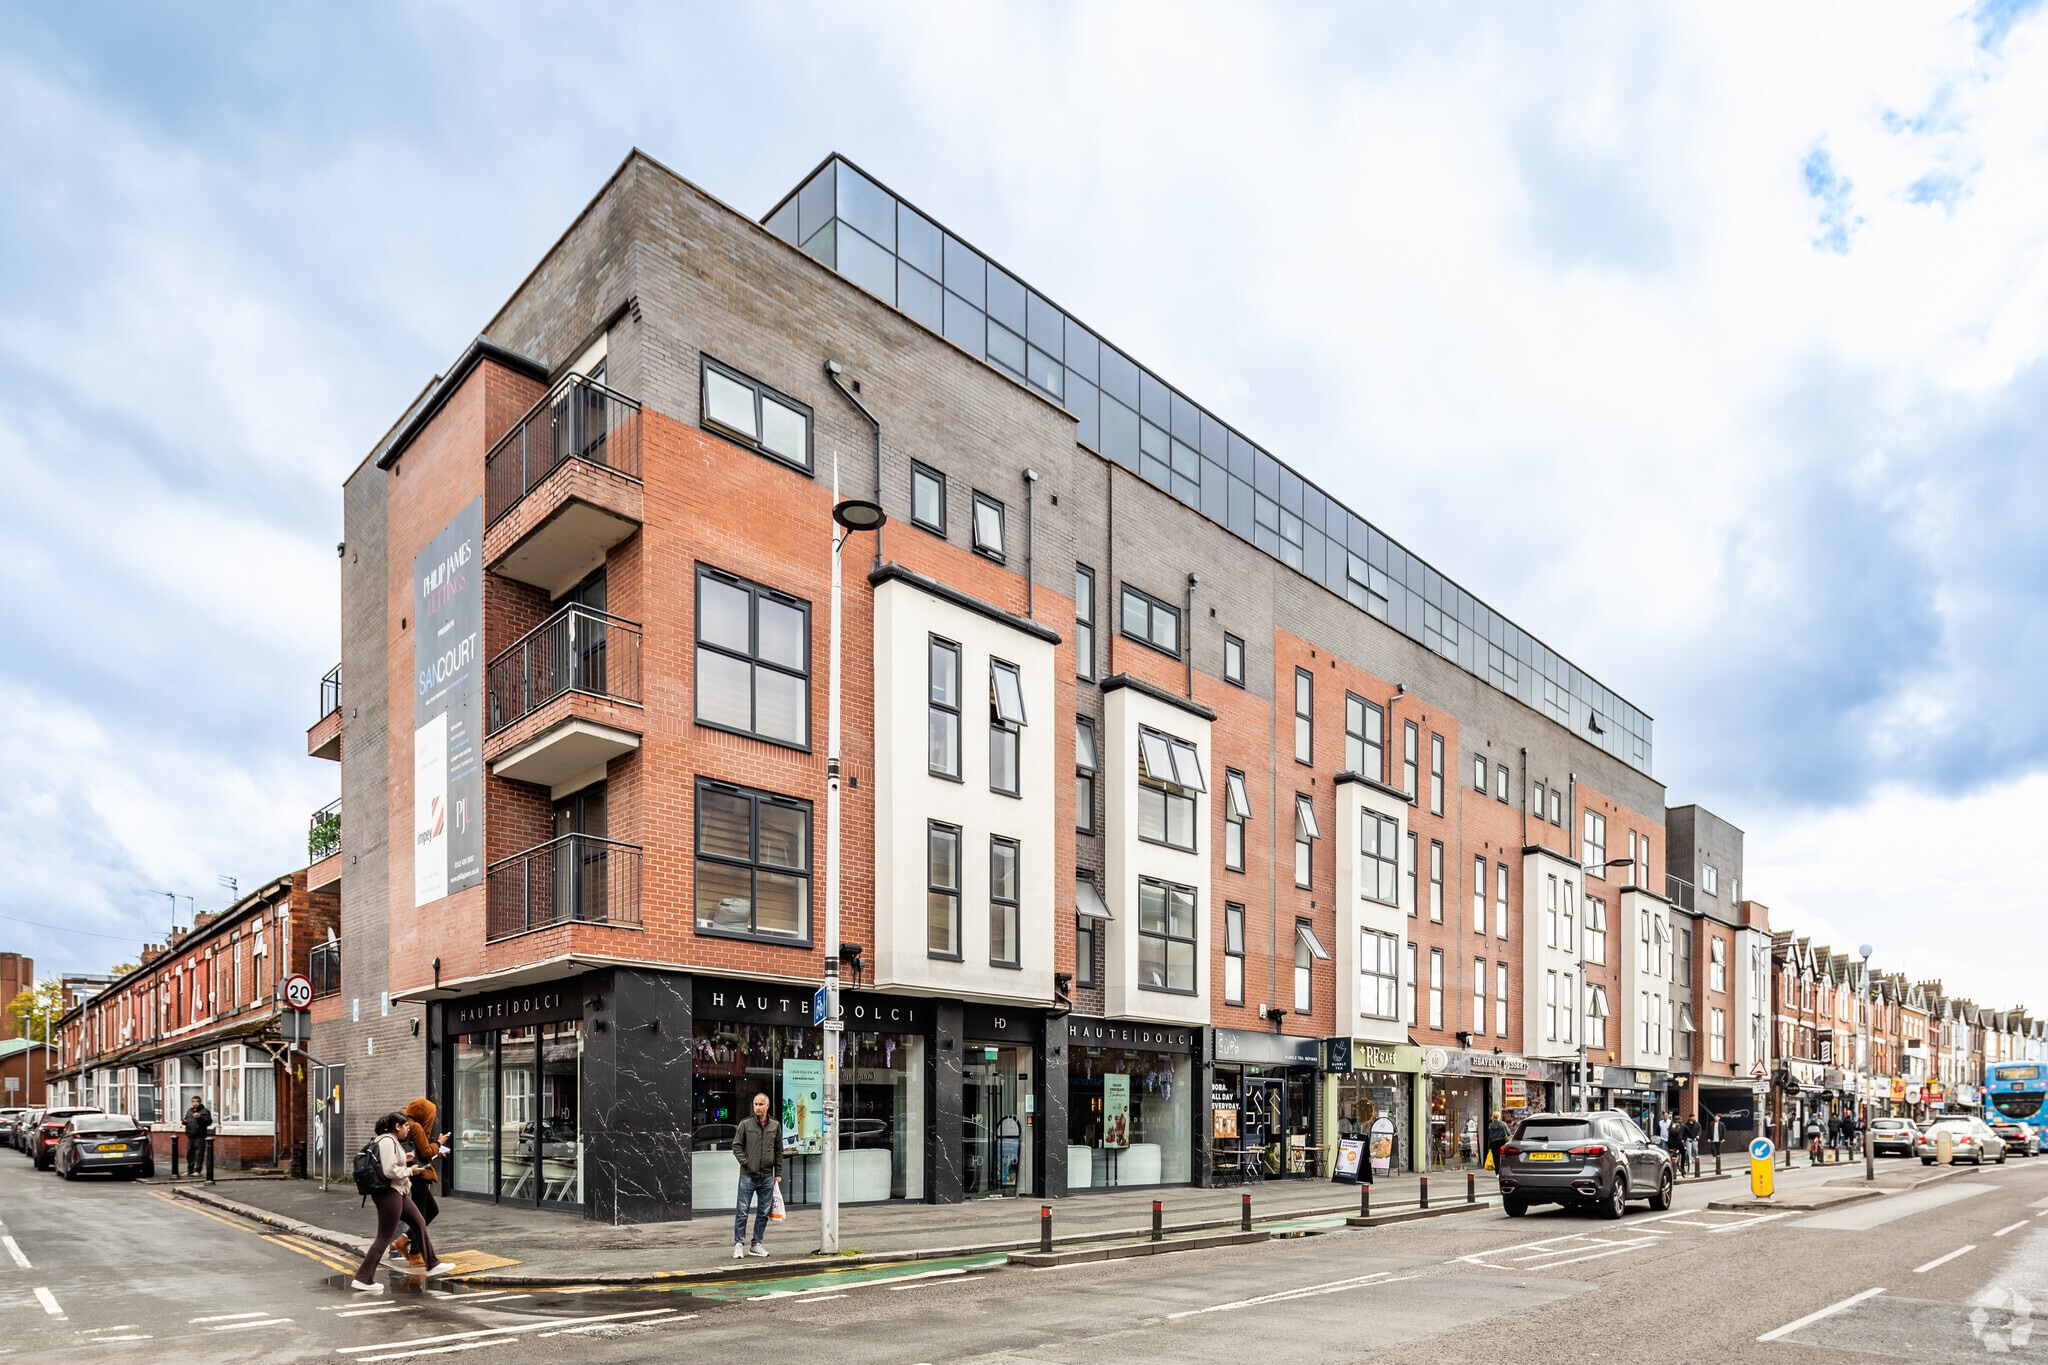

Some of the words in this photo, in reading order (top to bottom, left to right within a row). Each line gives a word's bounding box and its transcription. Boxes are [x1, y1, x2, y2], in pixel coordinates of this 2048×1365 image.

[424, 562, 446, 598] PHILIP
[446, 539, 472, 585] JAMES
[427, 569, 467, 617] LETTINGS
[419, 632, 477, 696] SANCOURT
[290, 985, 310, 1000] 20
[460, 1003, 502, 1021] HAUTE
[513, 993, 559, 1013] DOLCI
[712, 993, 809, 1014] HAUTE
[994, 1017, 1007, 1029] HD
[1069, 1025, 1128, 1040] HAUTE
[1143, 1032, 1193, 1045] DOLCI
[1472, 1057, 1502, 1067] HEAVENLY
[1503, 1059, 1530, 1070] DESSERTS
[1211, 1102, 1241, 1110] EVERYDAY.
[1212, 1093, 1222, 1101] ALL
[1222, 1093, 1234, 1101] DAY
